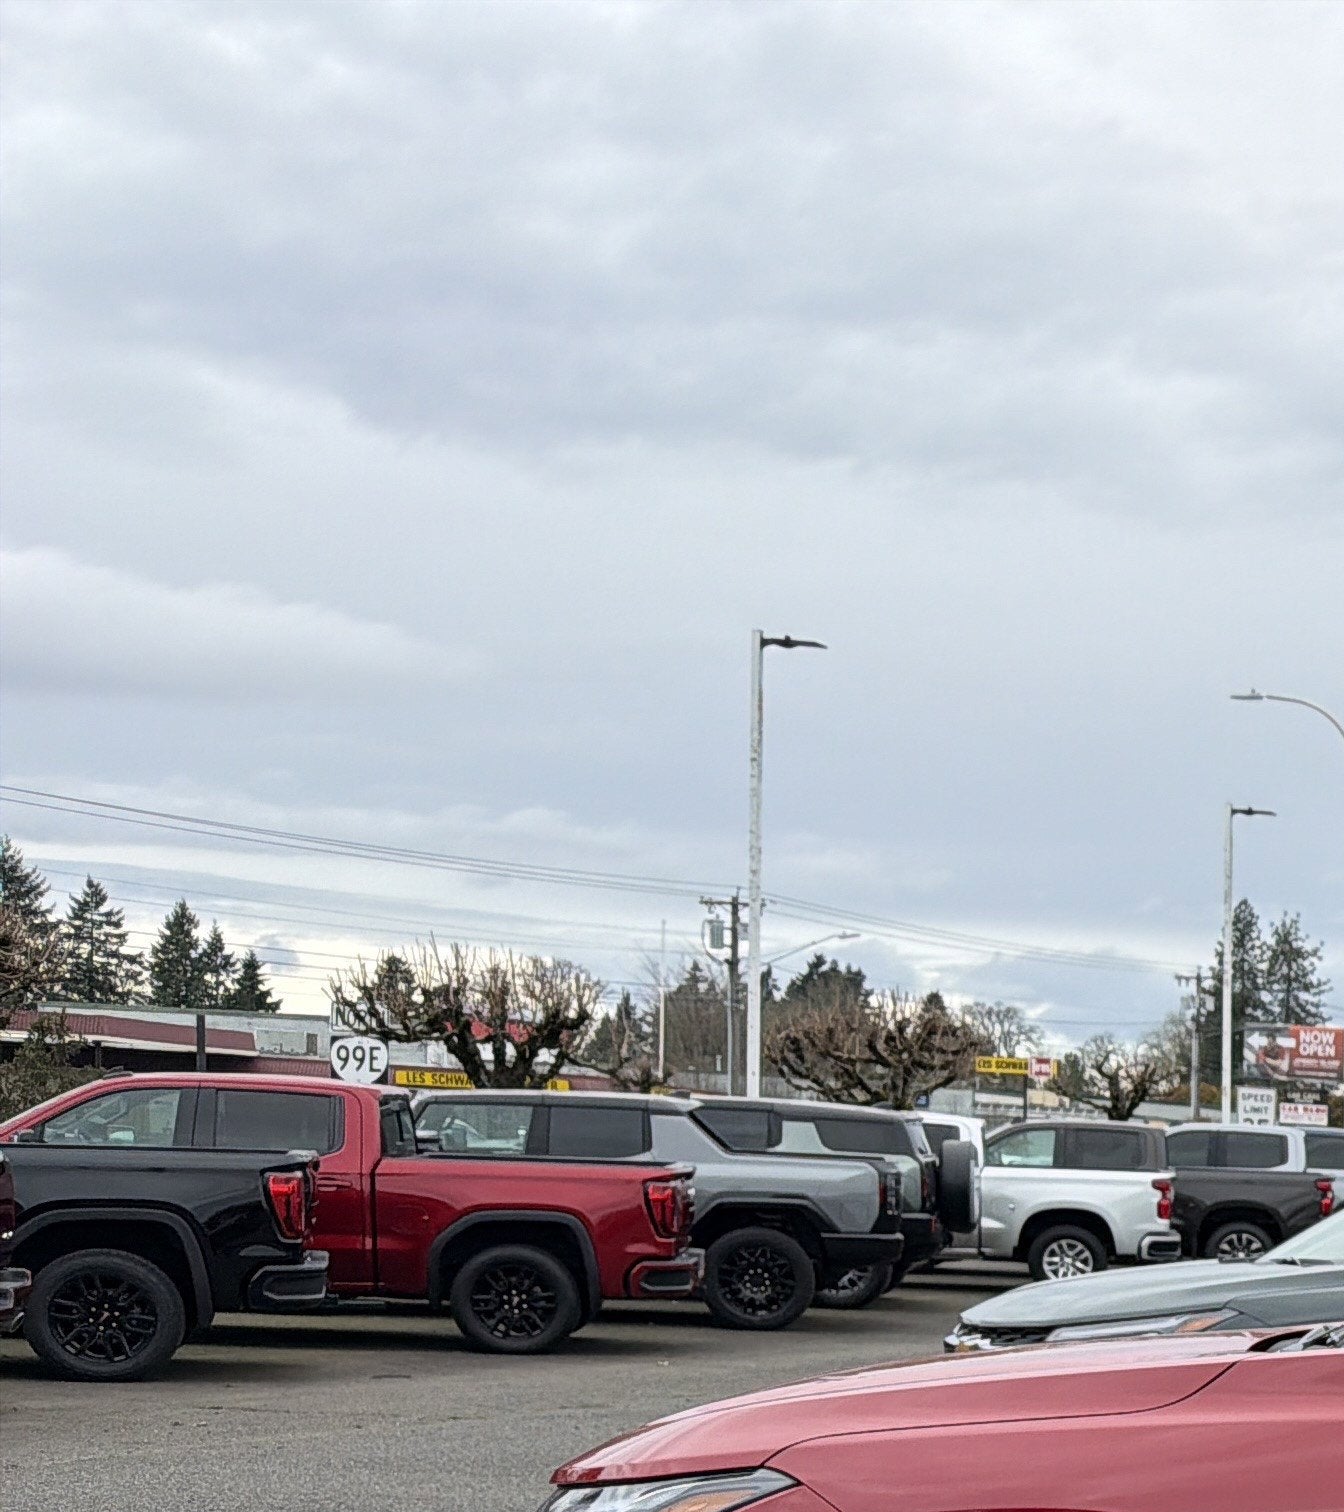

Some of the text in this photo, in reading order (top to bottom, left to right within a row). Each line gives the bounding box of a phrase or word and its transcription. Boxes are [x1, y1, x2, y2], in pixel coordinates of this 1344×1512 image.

[1299, 1030, 1336, 1045] NOW
[1299, 1043, 1336, 1058] OPEN
[336, 1045, 383, 1073] 99E
[406, 1071, 426, 1084] LES
[1241, 1092, 1273, 1103] SPEED
[1243, 1105, 1269, 1115] LIMIT
